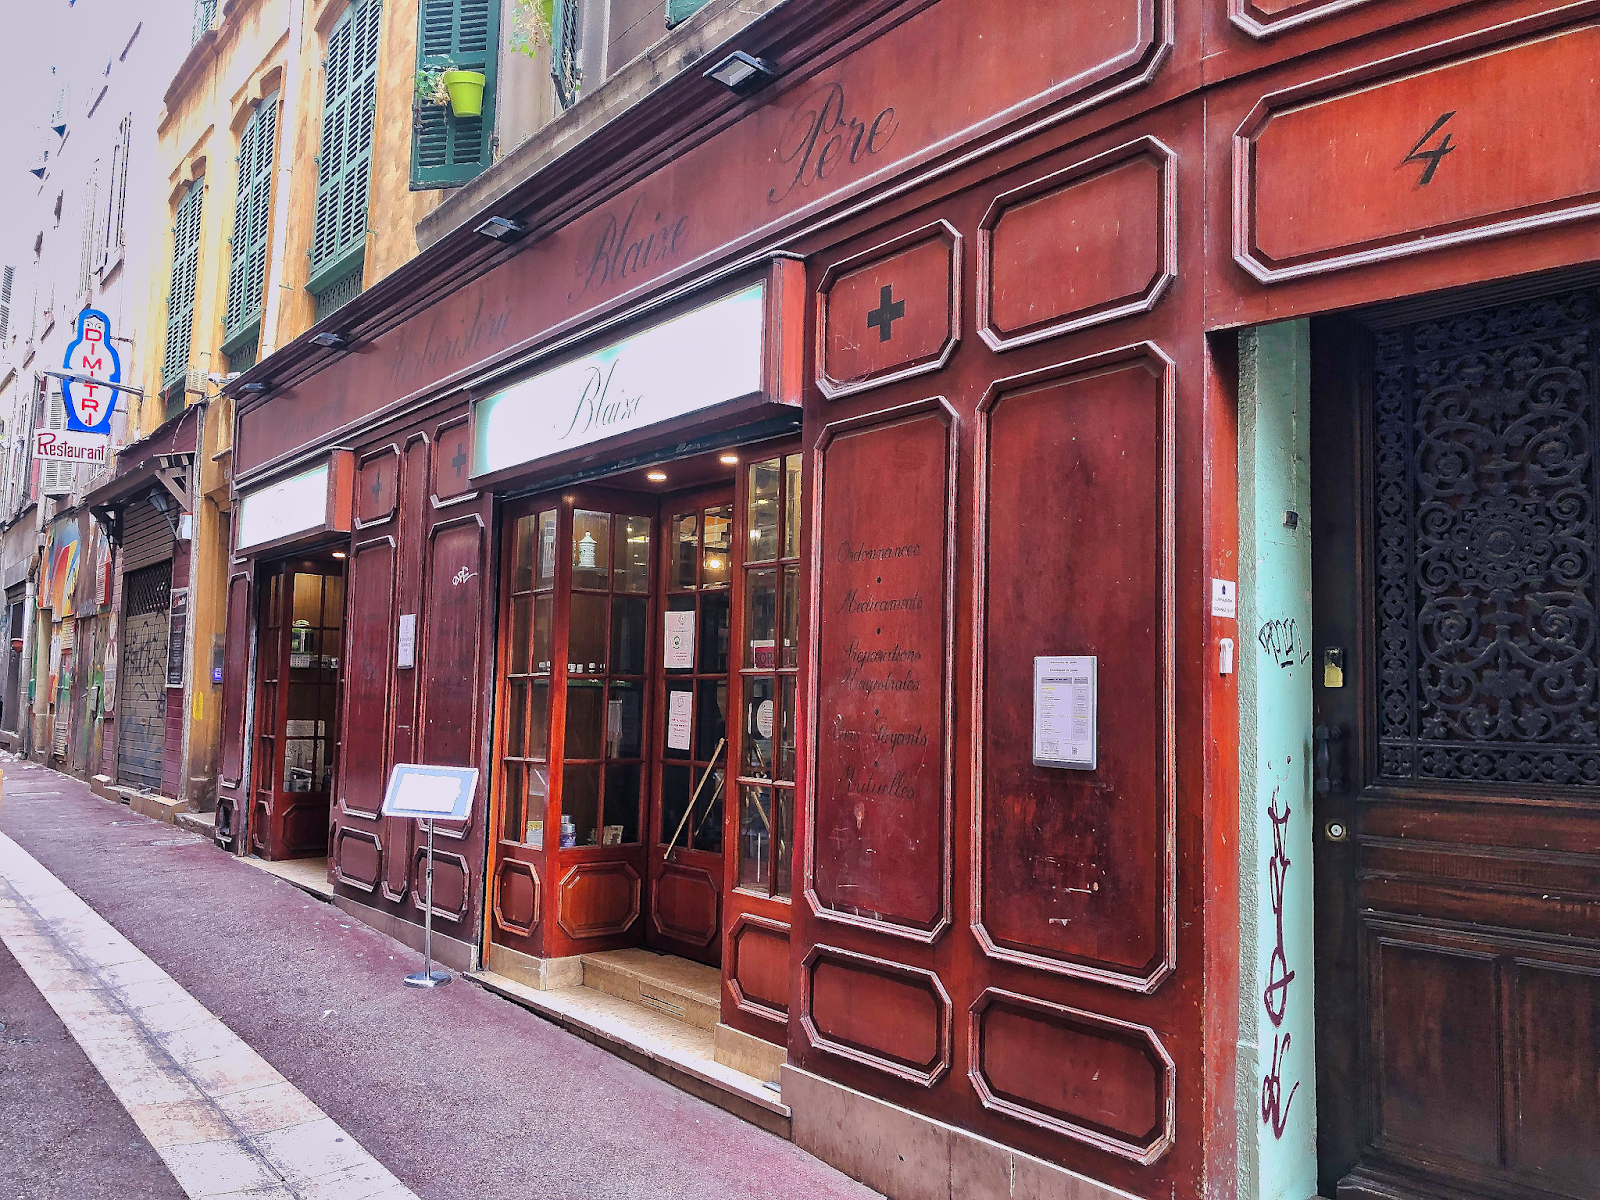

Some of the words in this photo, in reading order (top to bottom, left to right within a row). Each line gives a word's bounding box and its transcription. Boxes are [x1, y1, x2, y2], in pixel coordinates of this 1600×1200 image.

[1395, 110, 1458, 189] 4
[567, 191, 690, 304] Blaise
[81, 327, 103, 426] DIMITRI
[553, 358, 645, 441] Blaise
[37, 432, 105, 461] Restaurant
[841, 765, 915, 800] Mutuelles
